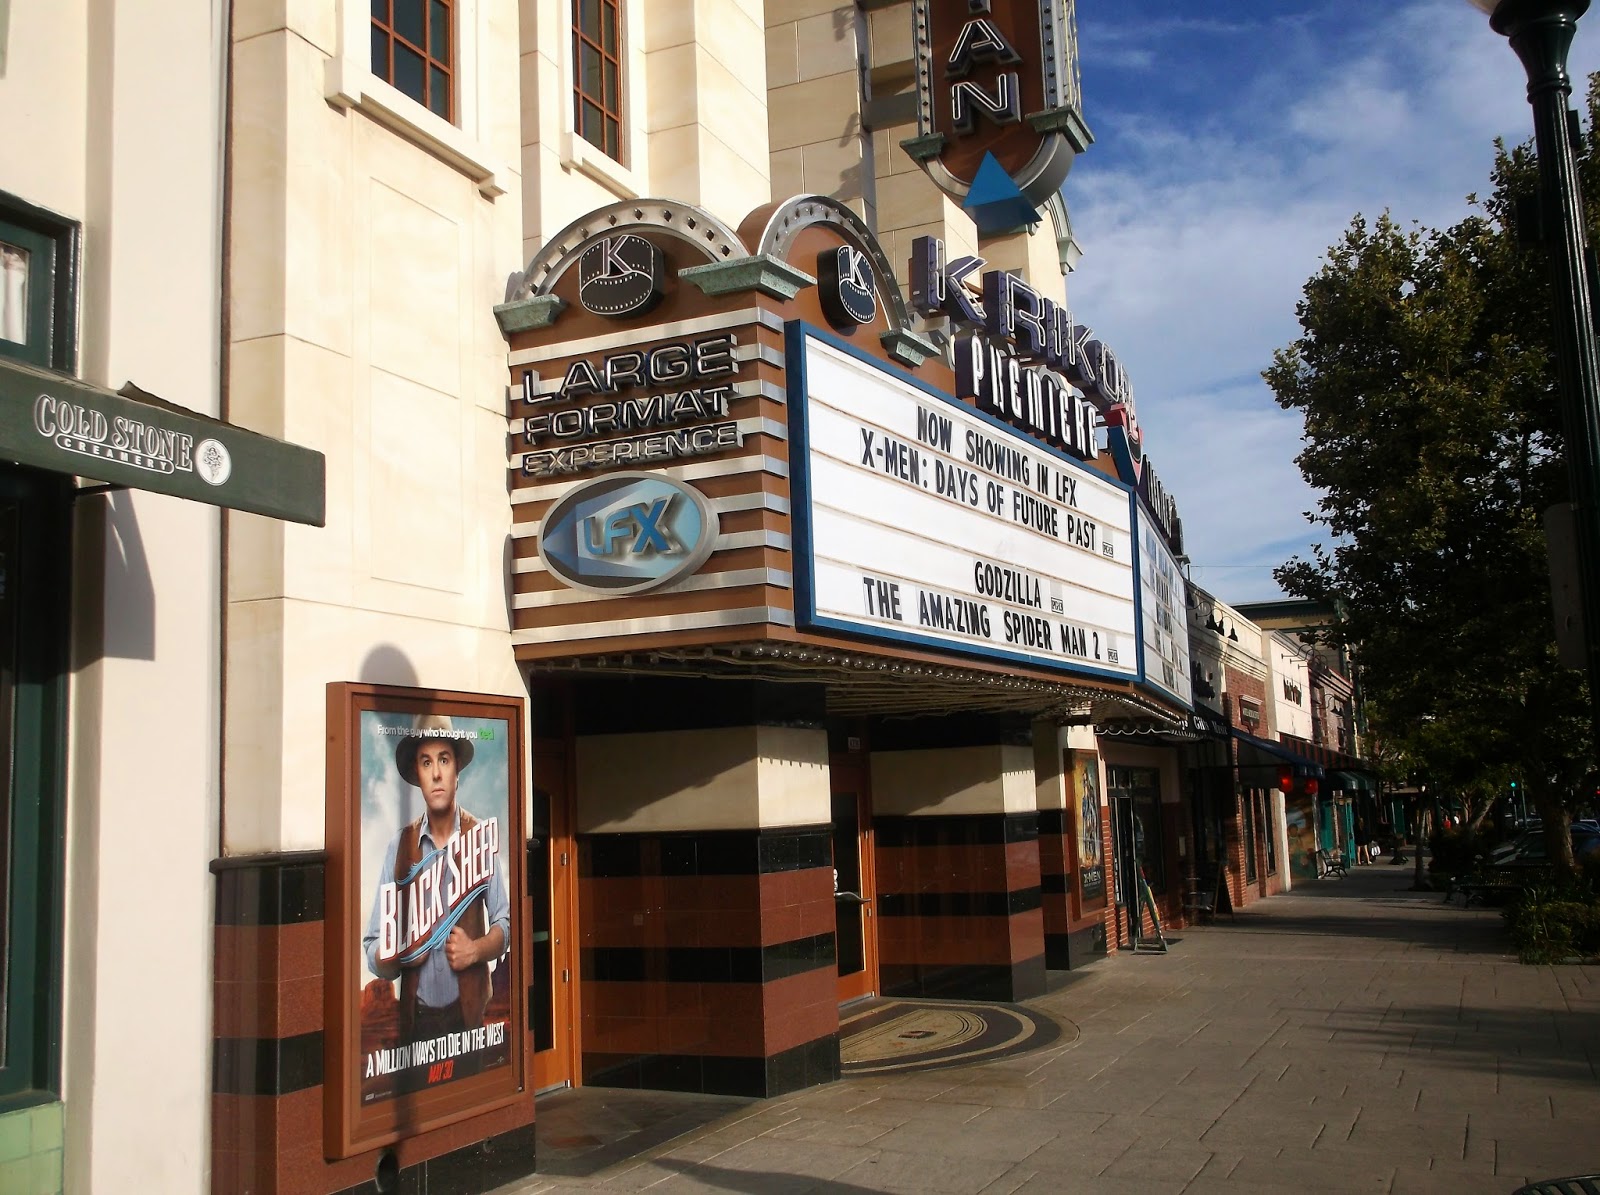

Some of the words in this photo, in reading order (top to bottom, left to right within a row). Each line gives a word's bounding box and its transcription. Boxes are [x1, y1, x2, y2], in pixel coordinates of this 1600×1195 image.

[523, 333, 739, 405] LARGE
[957, 336, 1099, 460] PREMIERE
[34, 394, 108, 443] COLD
[112, 416, 194, 473] STONE
[524, 383, 739, 444] FORMAT
[64, 437, 169, 471] CREAMERY
[522, 422, 743, 477] EXPERIENCE
[917, 405, 952, 453] NOW
[965, 430, 1030, 486] SHOWING
[1037, 462, 1049, 496] IN
[1056, 470, 1077, 507] LFX
[861, 428, 929, 489] X-MEN:
[935, 462, 979, 506] DAYS
[986, 480, 1004, 516] OF
[1013, 490, 1058, 537] FUTURE
[1067, 515, 1096, 550] PAST
[583, 493, 685, 556] LFX
[974, 561, 1042, 609] GODZILLA
[863, 577, 902, 621] THE
[919, 590, 990, 638] AMAZING
[1004, 611, 1052, 650] SPIDER
[1060, 624, 1087, 657] MAN
[1092, 631, 1101, 660] 2
[377, 725, 397, 736] From
[397, 726, 409, 736] the
[410, 728, 423, 739] guy
[423, 727, 439, 738] who
[439, 728, 465, 740] brought
[465, 730, 478, 740] you
[380, 855, 445, 960] BLACK
[447, 817, 499, 907] SHEEP
[366, 1053, 374, 1079] A
[375, 1045, 411, 1077] MILLION
[412, 1039, 436, 1067] WAYS
[436, 1036, 447, 1061] TO
[448, 1033, 461, 1058] DIE
[461, 1030, 471, 1054] IN
[471, 1027, 486, 1052] THE
[486, 1021, 505, 1047] WEST
[428, 1063, 442, 1084] MAY
